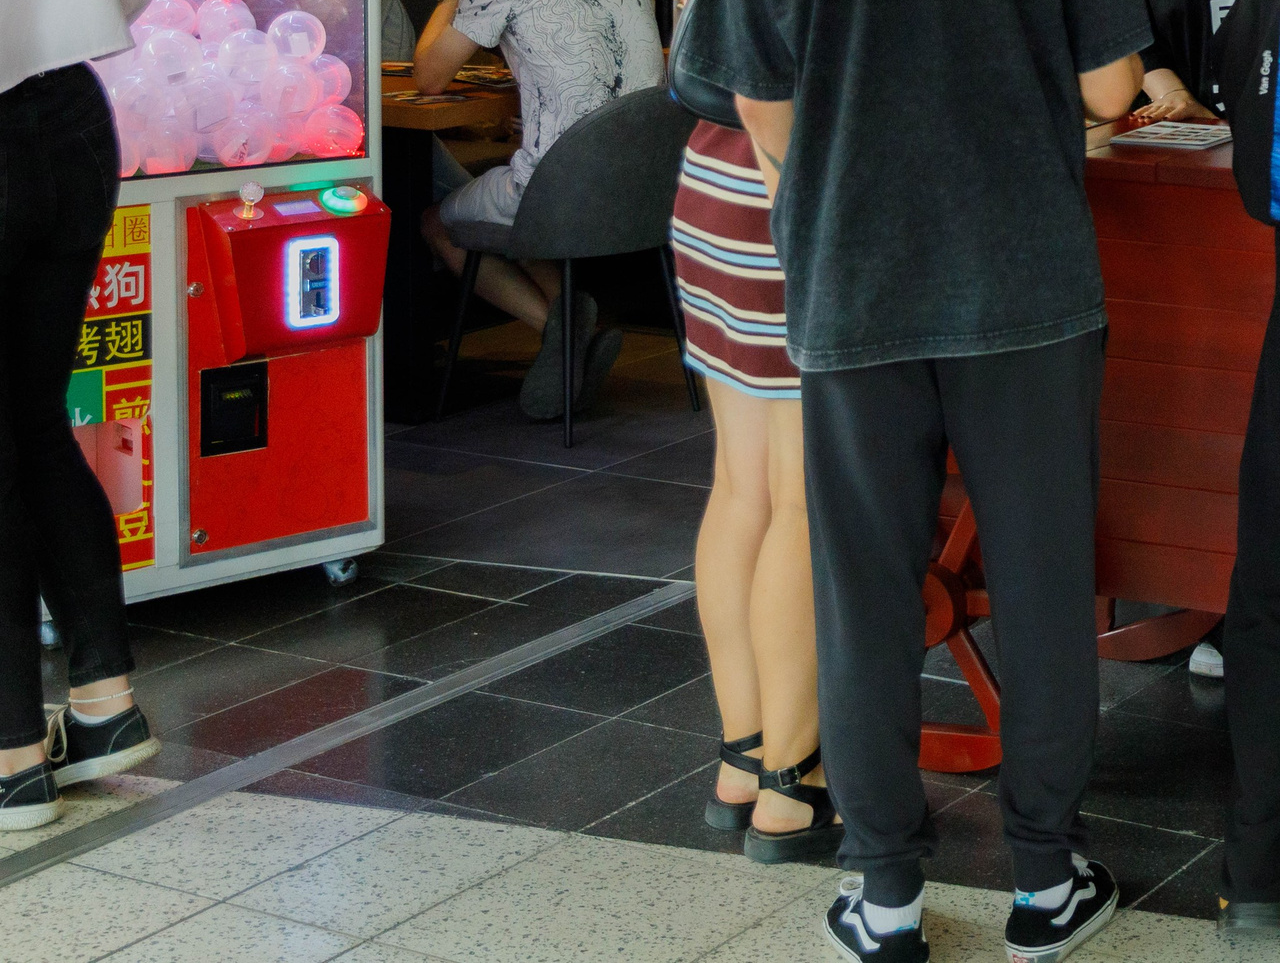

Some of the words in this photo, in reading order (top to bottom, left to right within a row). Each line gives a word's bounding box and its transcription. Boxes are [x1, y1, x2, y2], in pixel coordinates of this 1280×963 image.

[1260, 49, 1274, 75] Gogh
[1258, 76, 1270, 96] Van
[88, 261, 145, 310] 狗
